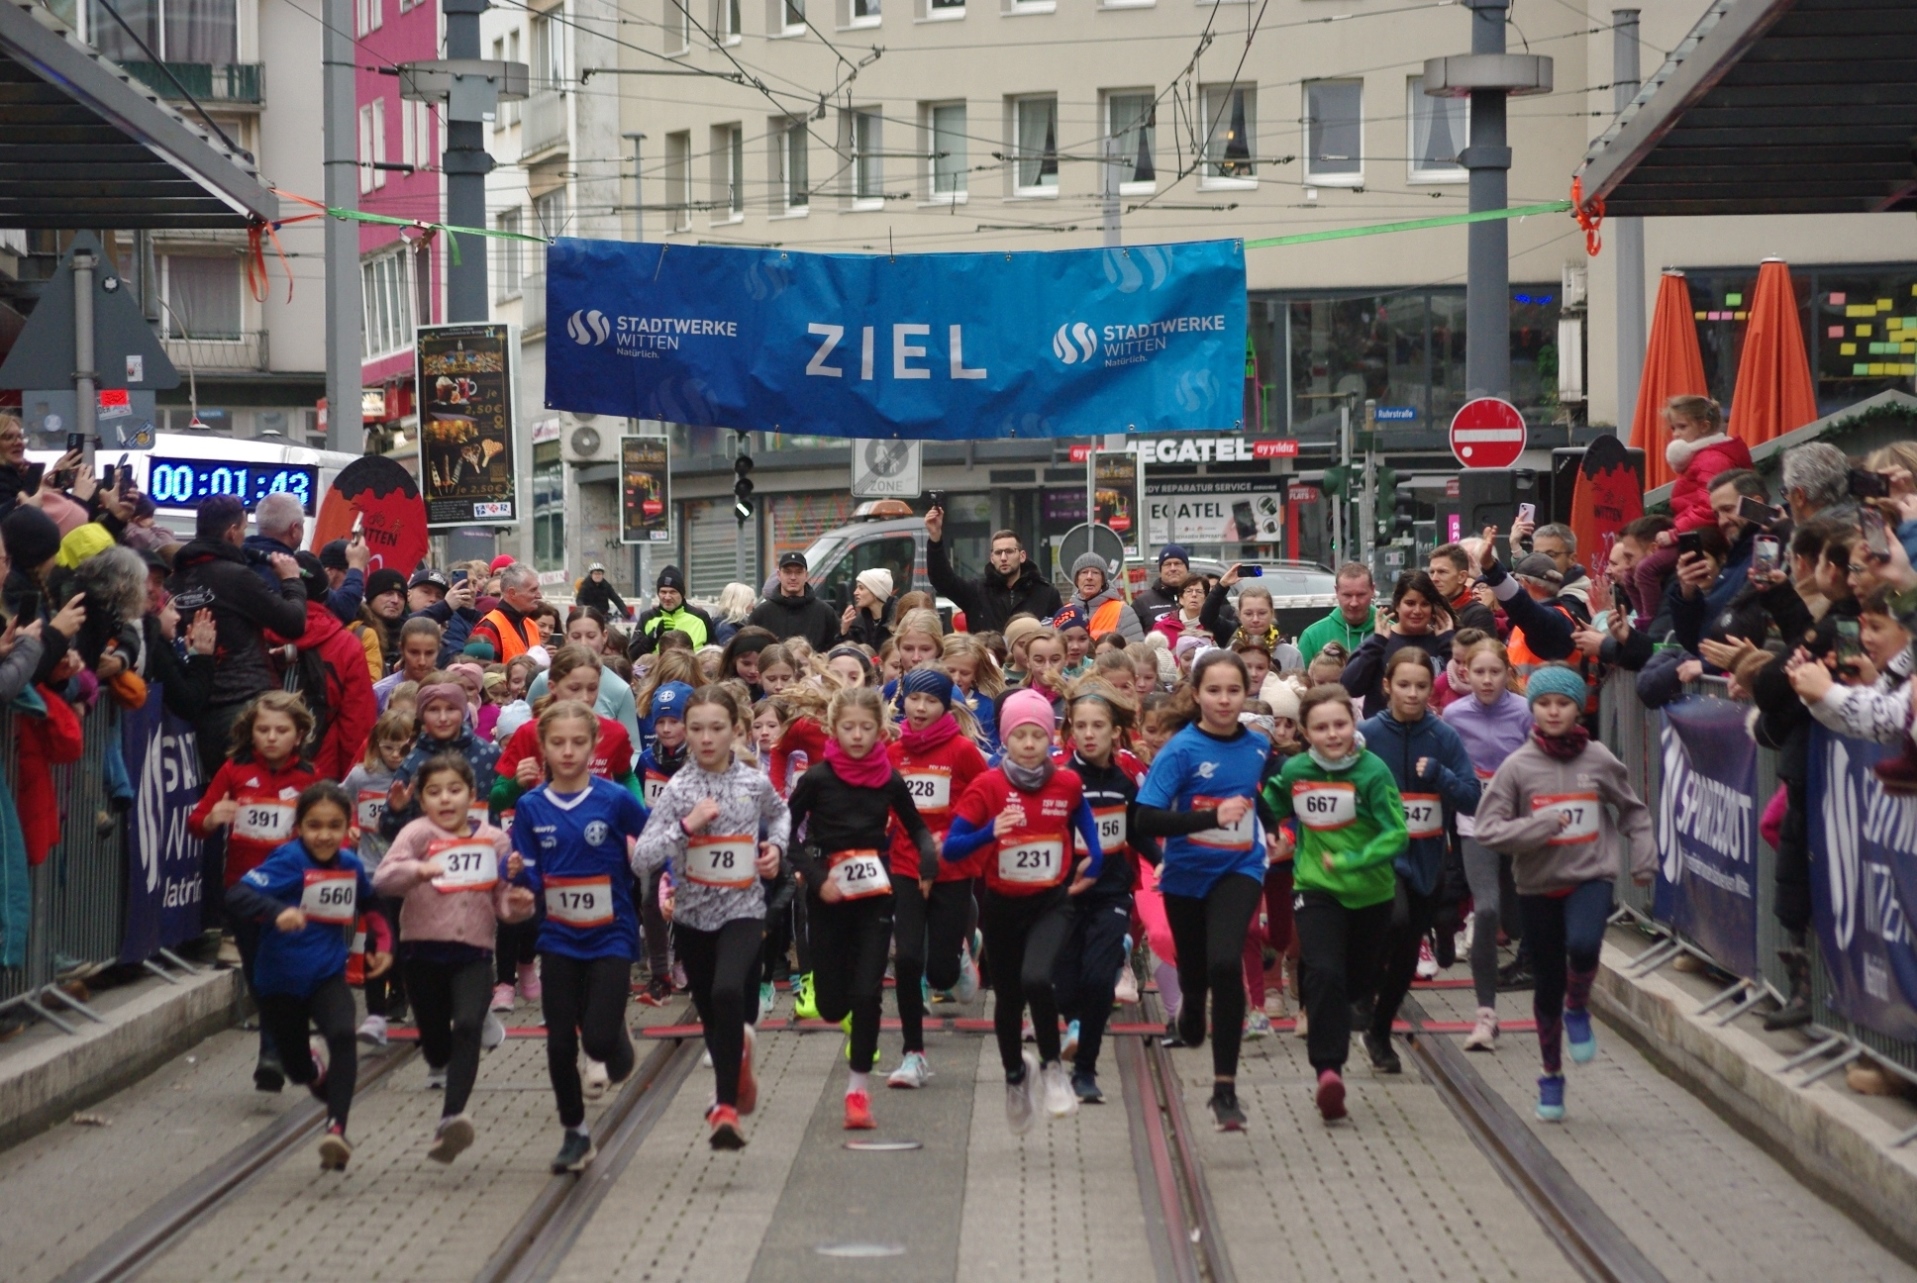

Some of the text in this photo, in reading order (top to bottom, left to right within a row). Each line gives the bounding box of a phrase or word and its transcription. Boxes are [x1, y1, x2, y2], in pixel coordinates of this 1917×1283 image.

[617, 315, 738, 337] STADTWERKE
[1103, 315, 1225, 342] STADTWERKE
[616, 332, 679, 350] WITTEN
[1104, 336, 1167, 357] WITTEN
[616, 347, 660, 359] Natürlich.
[805, 322, 987, 381] ZIEL
[1105, 355, 1148, 368] Natürlich.
[465, 403, 503, 415] 2,50€
[1378, 408, 1414, 420] Ruhrstraße
[1126, 438, 1254, 463] EGATEL
[470, 484, 503, 494] 2,50€
[870, 480, 903, 492] ZONE
[1161, 483, 1213, 493] REPARATUR
[1214, 482, 1252, 491] SERVICE
[1151, 502, 1224, 519] EGATEL
[906, 780, 935, 797] 228
[1306, 796, 1338, 813] 667
[247, 809, 279, 828] 391
[447, 853, 482, 872] 377
[709, 850, 735, 869] 78
[1016, 850, 1051, 868] 231
[844, 862, 878, 882] 225
[318, 886, 353, 905] 560
[559, 892, 595, 910] 179
